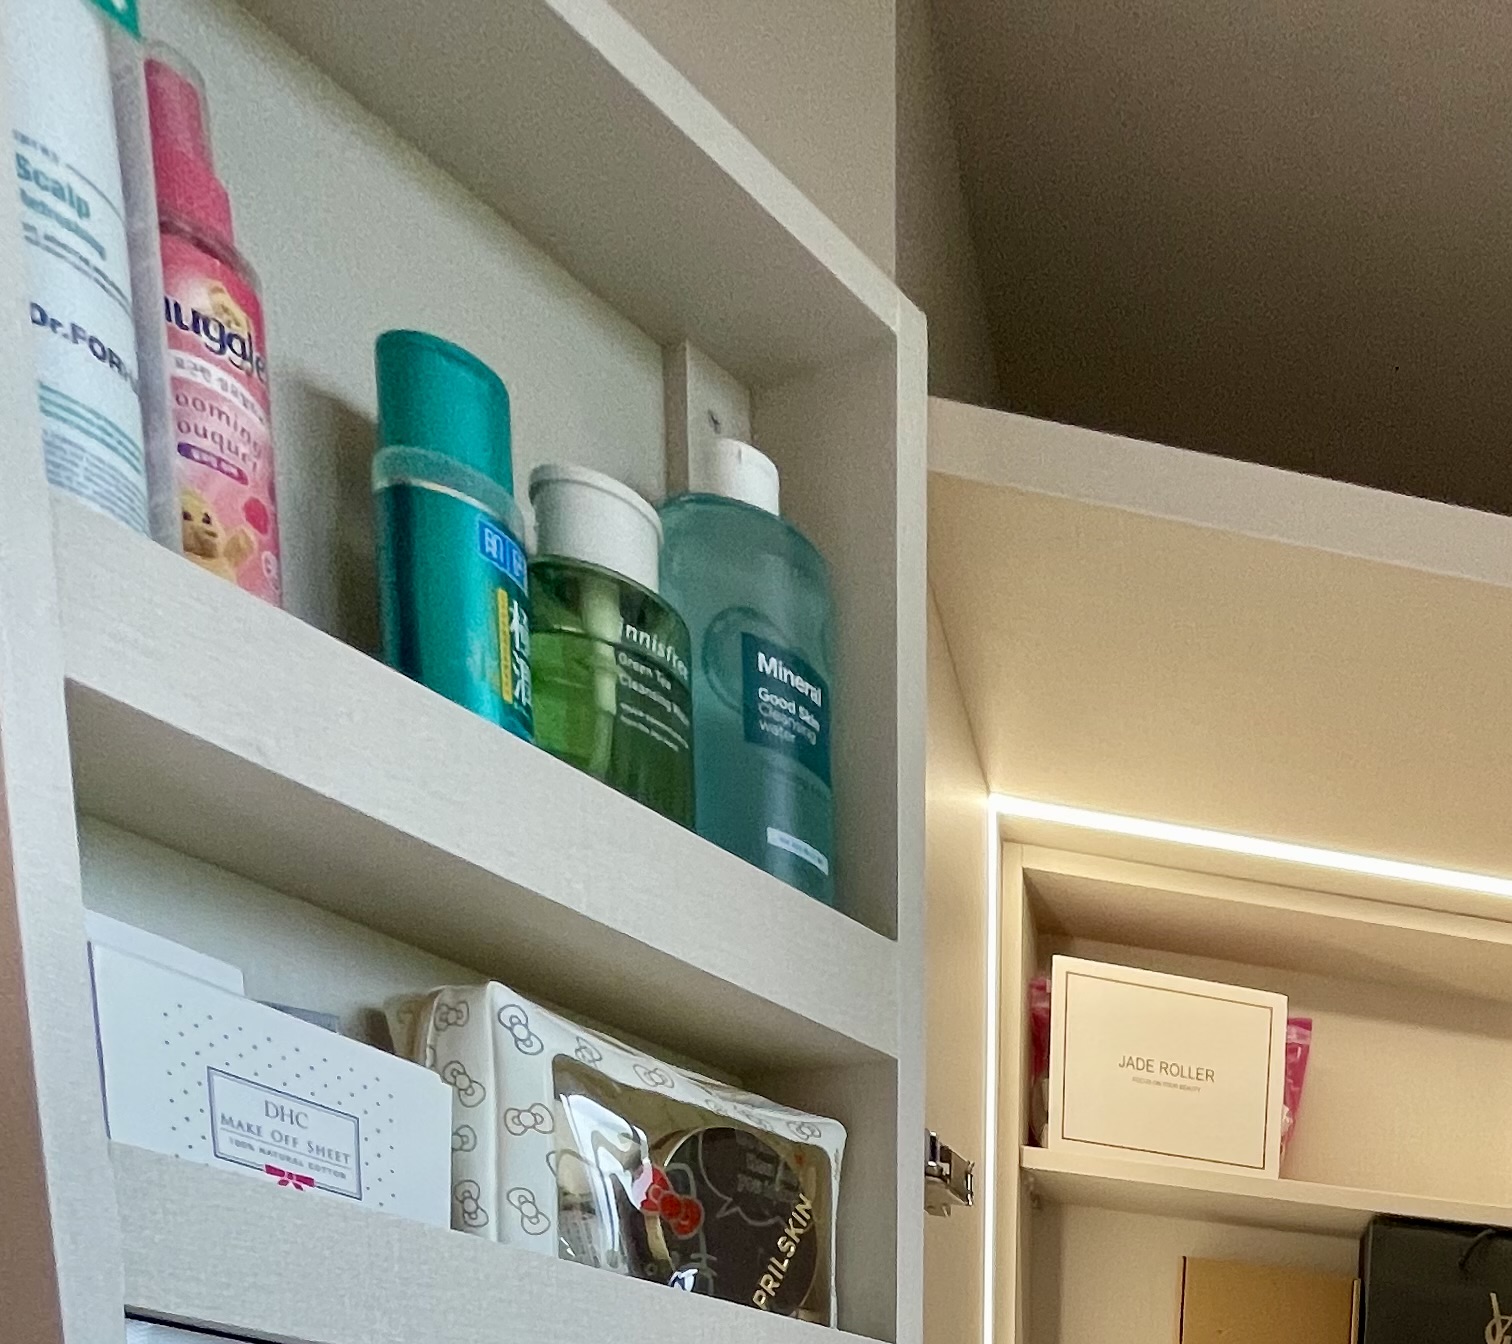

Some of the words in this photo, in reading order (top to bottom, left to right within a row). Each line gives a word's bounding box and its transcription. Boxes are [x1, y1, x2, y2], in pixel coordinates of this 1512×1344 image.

[15, 151, 91, 220] Scalp
[30, 302, 138, 392] Dr.FOR
[757, 650, 822, 708] Mineral
[758, 686, 796, 715] Good
[798, 704, 821, 733] Skin
[1118, 1056, 1155, 1073] JADE
[1159, 1061, 1215, 1083] ROLLER
[221, 1112, 263, 1137] MAKE
[271, 1129, 299, 1148] OFF
[307, 1140, 351, 1164] SHEET
[265, 1100, 309, 1130] DHC
[753, 1193, 814, 1311] PRILSKIN
